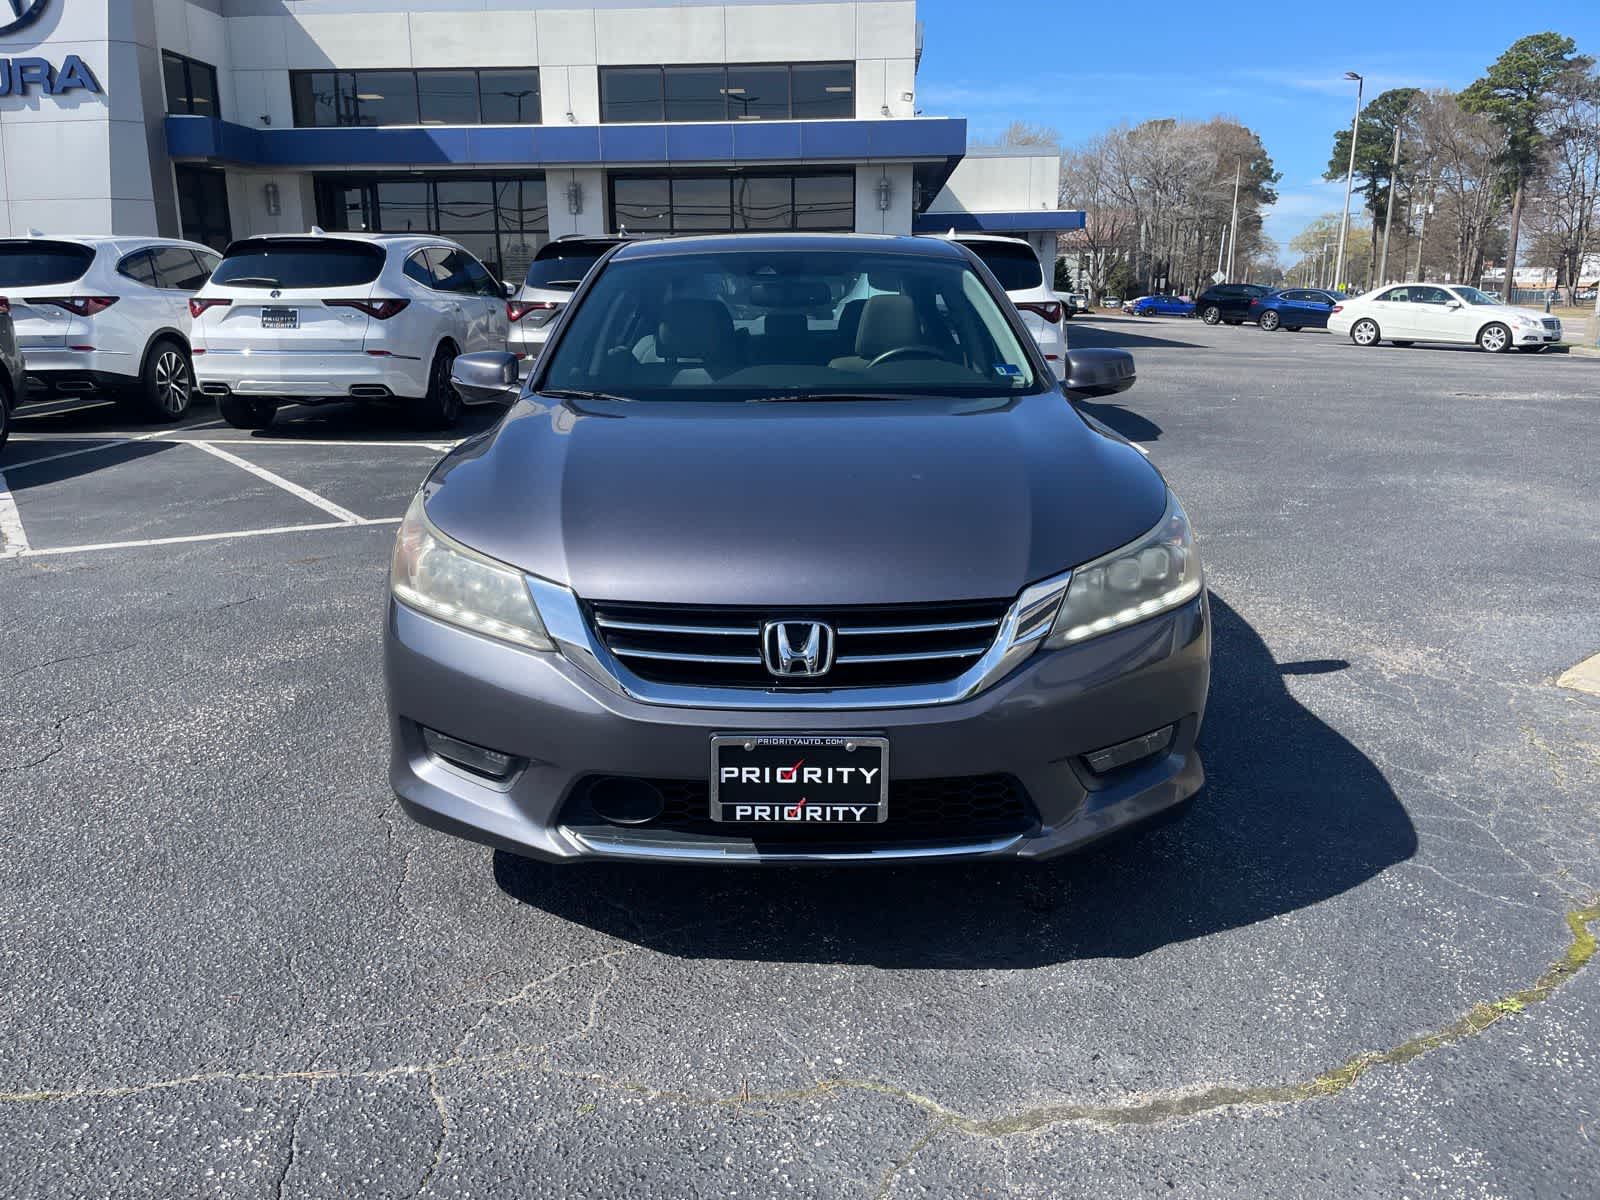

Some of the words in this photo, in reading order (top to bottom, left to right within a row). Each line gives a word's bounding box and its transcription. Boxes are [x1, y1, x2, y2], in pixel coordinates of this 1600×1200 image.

[757, 737, 843, 745] PRIORITYAUTO.COM
[720, 767, 879, 784] PRIORITY
[735, 806, 867, 821] PRIORITY
